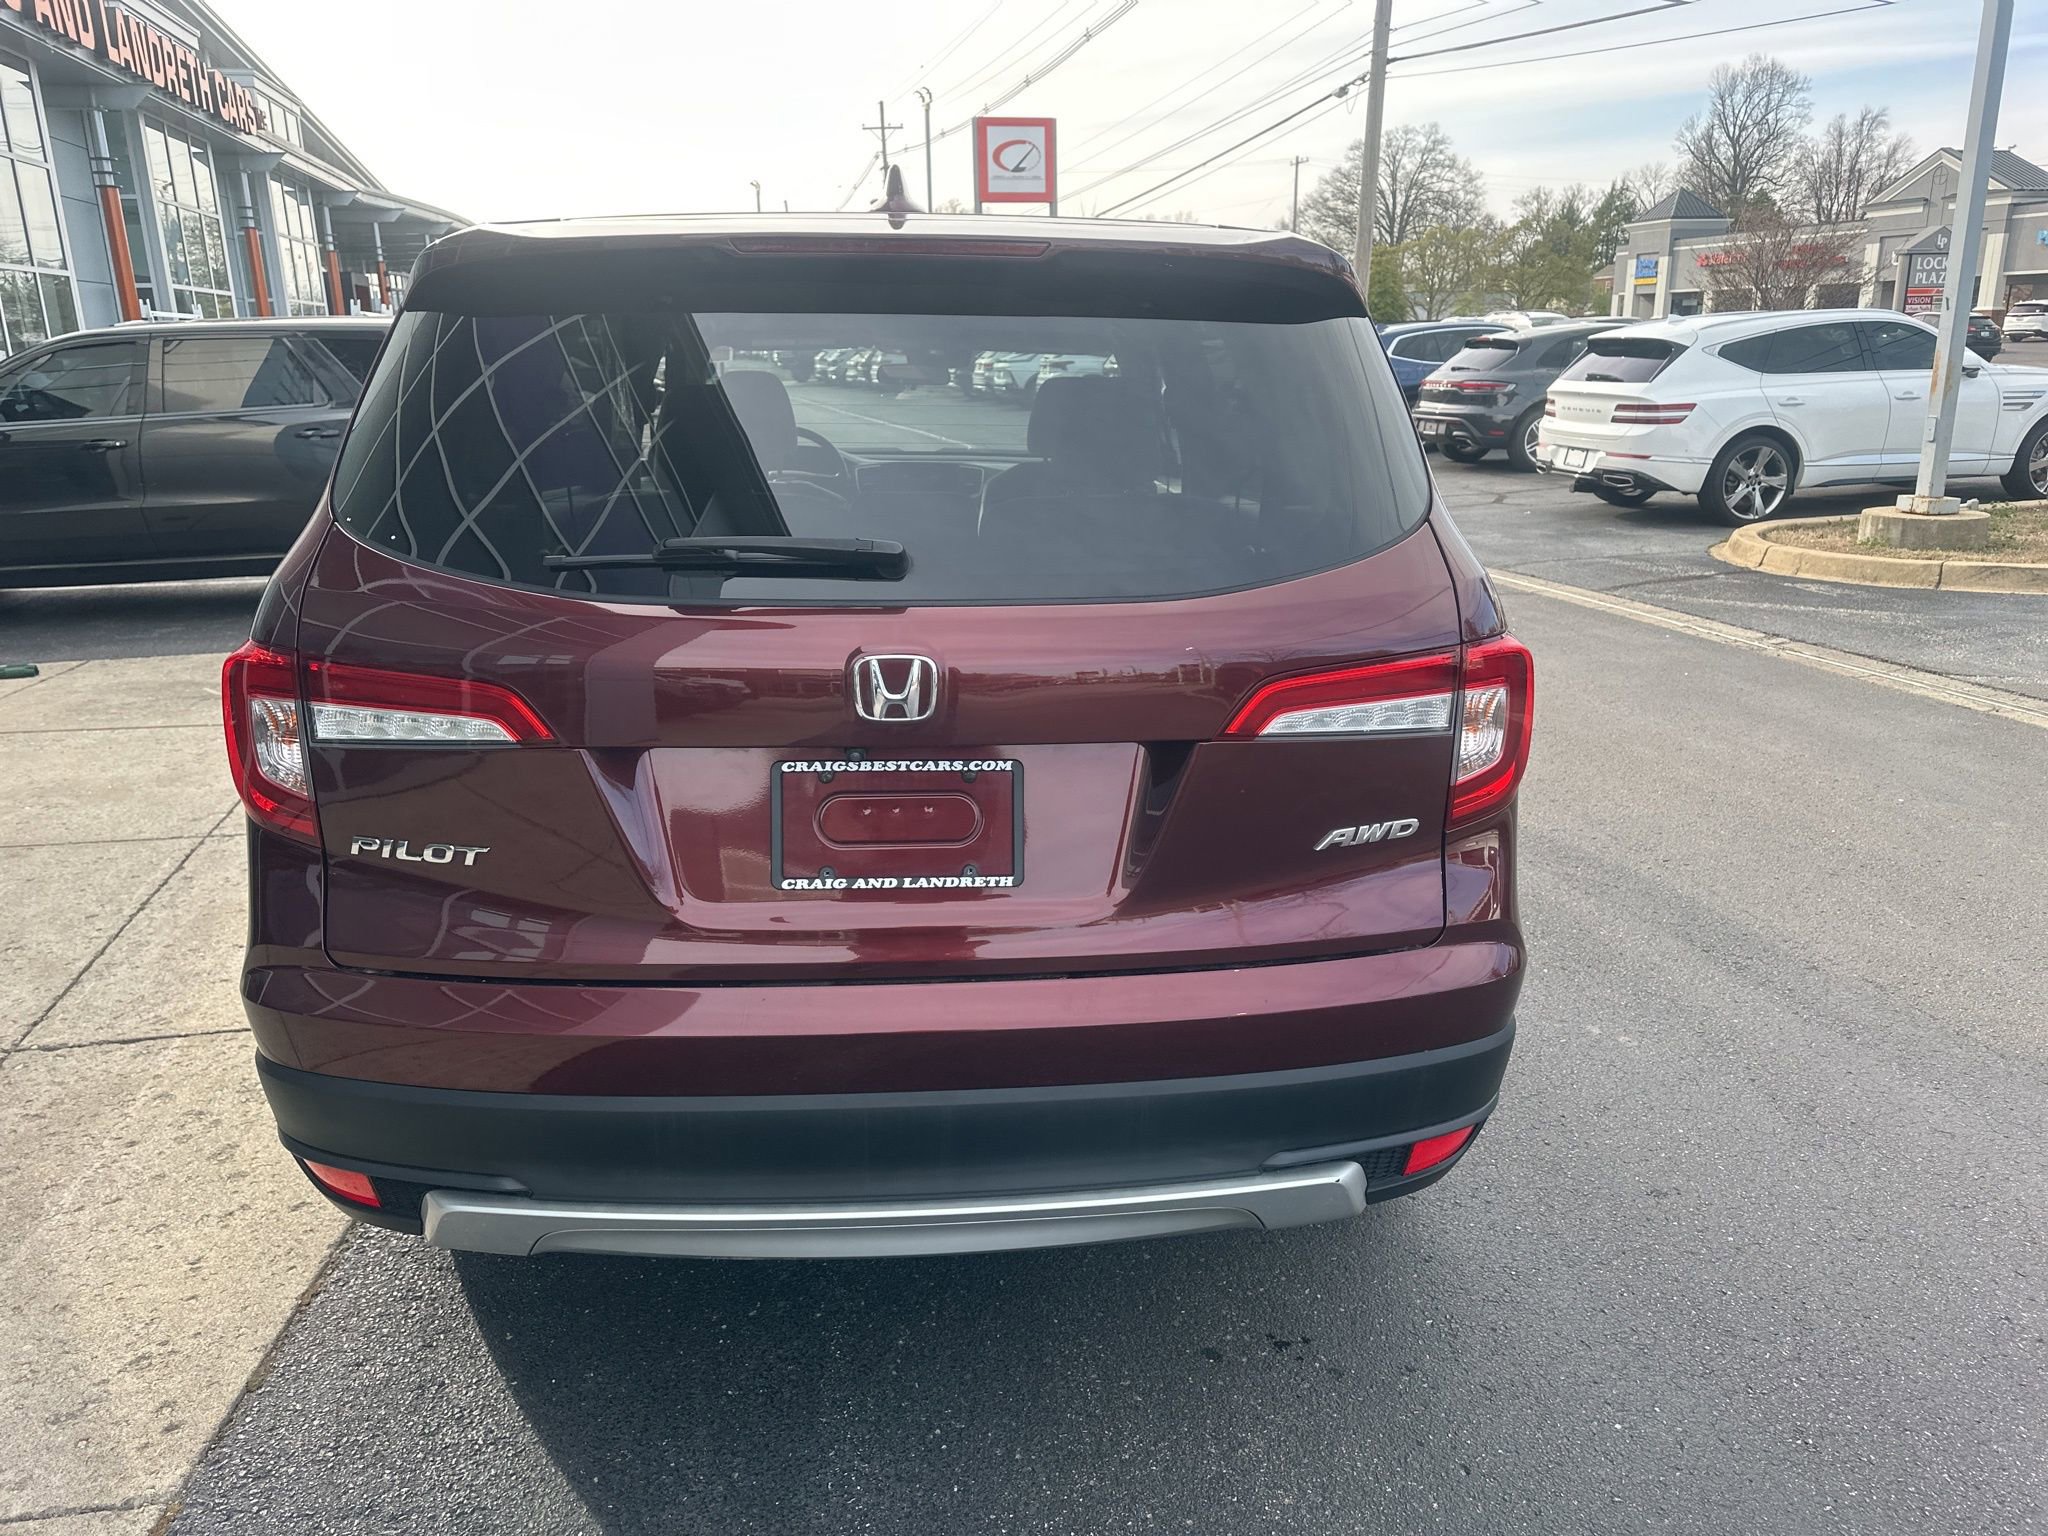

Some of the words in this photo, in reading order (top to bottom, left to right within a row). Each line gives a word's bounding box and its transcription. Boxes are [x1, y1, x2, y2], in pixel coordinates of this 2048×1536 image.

[98, 0, 214, 114] LANDRETH
[214, 69, 257, 136] CARS
[1907, 296, 1932, 304] VISION
[780, 760, 1014, 773] CRAIGSBESTCARS.COM
[1312, 818, 1420, 851] AWD
[350, 835, 491, 866] PILOT
[781, 877, 848, 890] CRAIG
[851, 877, 899, 889] AND
[902, 876, 1015, 889] LANDRETH
